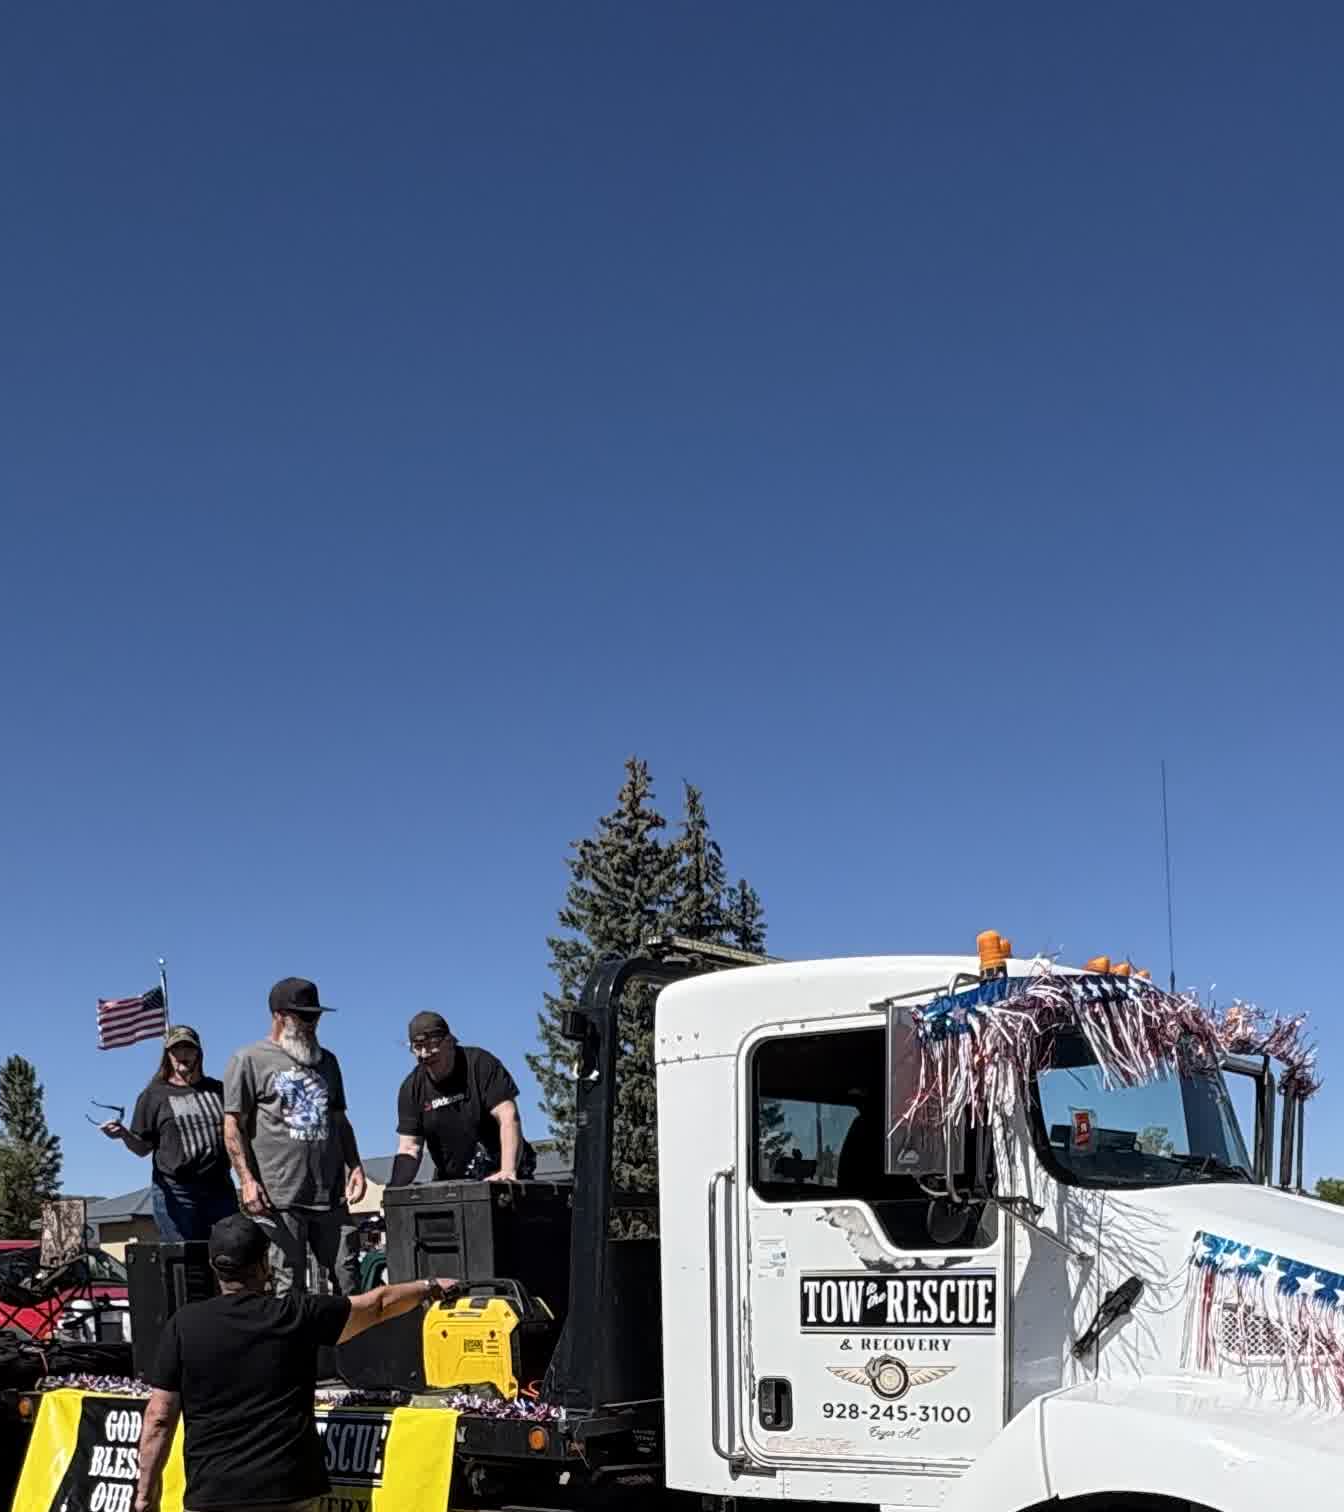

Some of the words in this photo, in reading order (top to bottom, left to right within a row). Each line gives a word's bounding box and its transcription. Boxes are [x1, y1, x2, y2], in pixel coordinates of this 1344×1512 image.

[803, 1280, 865, 1324] TOW
[886, 1280, 993, 1324] RESCUE
[839, 1338, 853, 1351] &
[861, 1338, 952, 1352] RECOVERY
[105, 1410, 142, 1443] GOD
[822, 1402, 972, 1424] 928-245-3100
[87, 1445, 142, 1480] BLES
